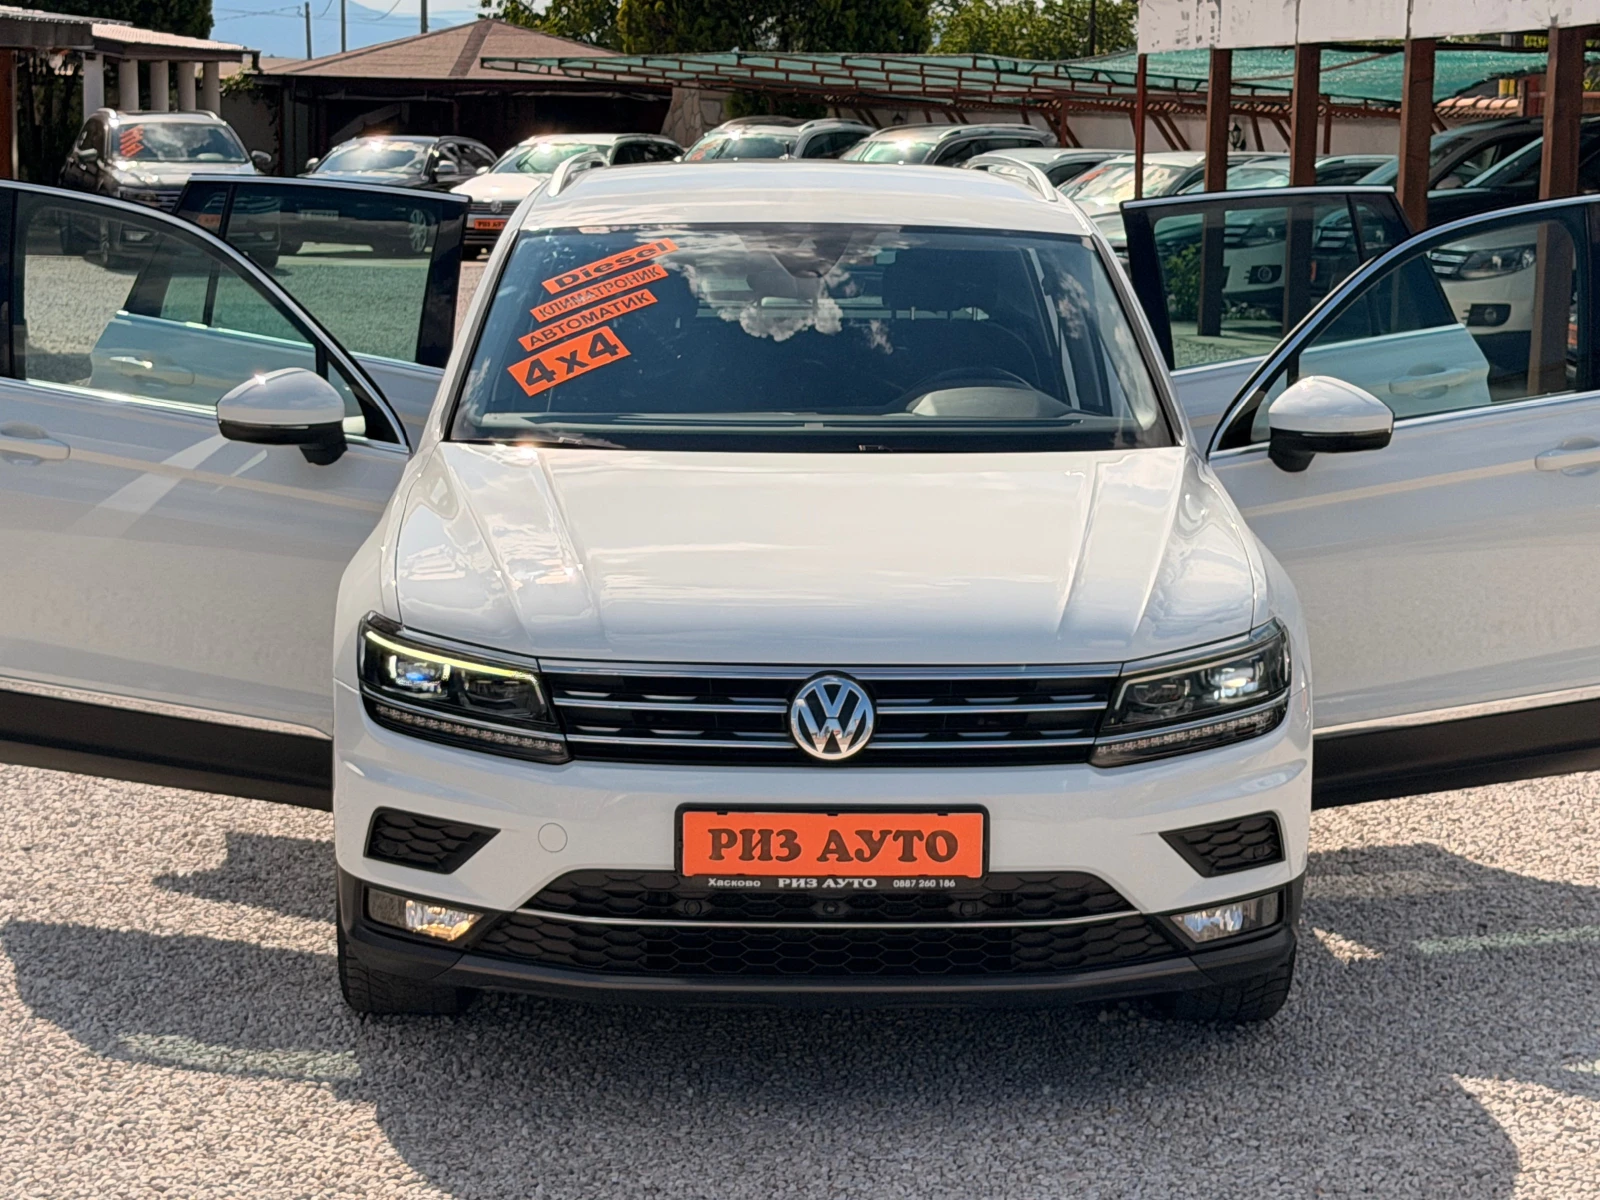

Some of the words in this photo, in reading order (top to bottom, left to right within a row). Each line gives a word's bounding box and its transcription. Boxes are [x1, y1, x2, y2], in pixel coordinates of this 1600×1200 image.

[554, 242, 669, 289] Diesel
[538, 266, 661, 318] КЛИМАТРОНИК
[529, 292, 650, 347] АВТОМАТИК
[707, 828, 803, 862] РИЗ
[816, 829, 959, 863] АУТО
[708, 878, 761, 887] Хасково
[778, 878, 818, 888] РИЗ
[822, 878, 877, 888] АУТО
[893, 879, 916, 888] 0887
[918, 879, 937, 888] 260
